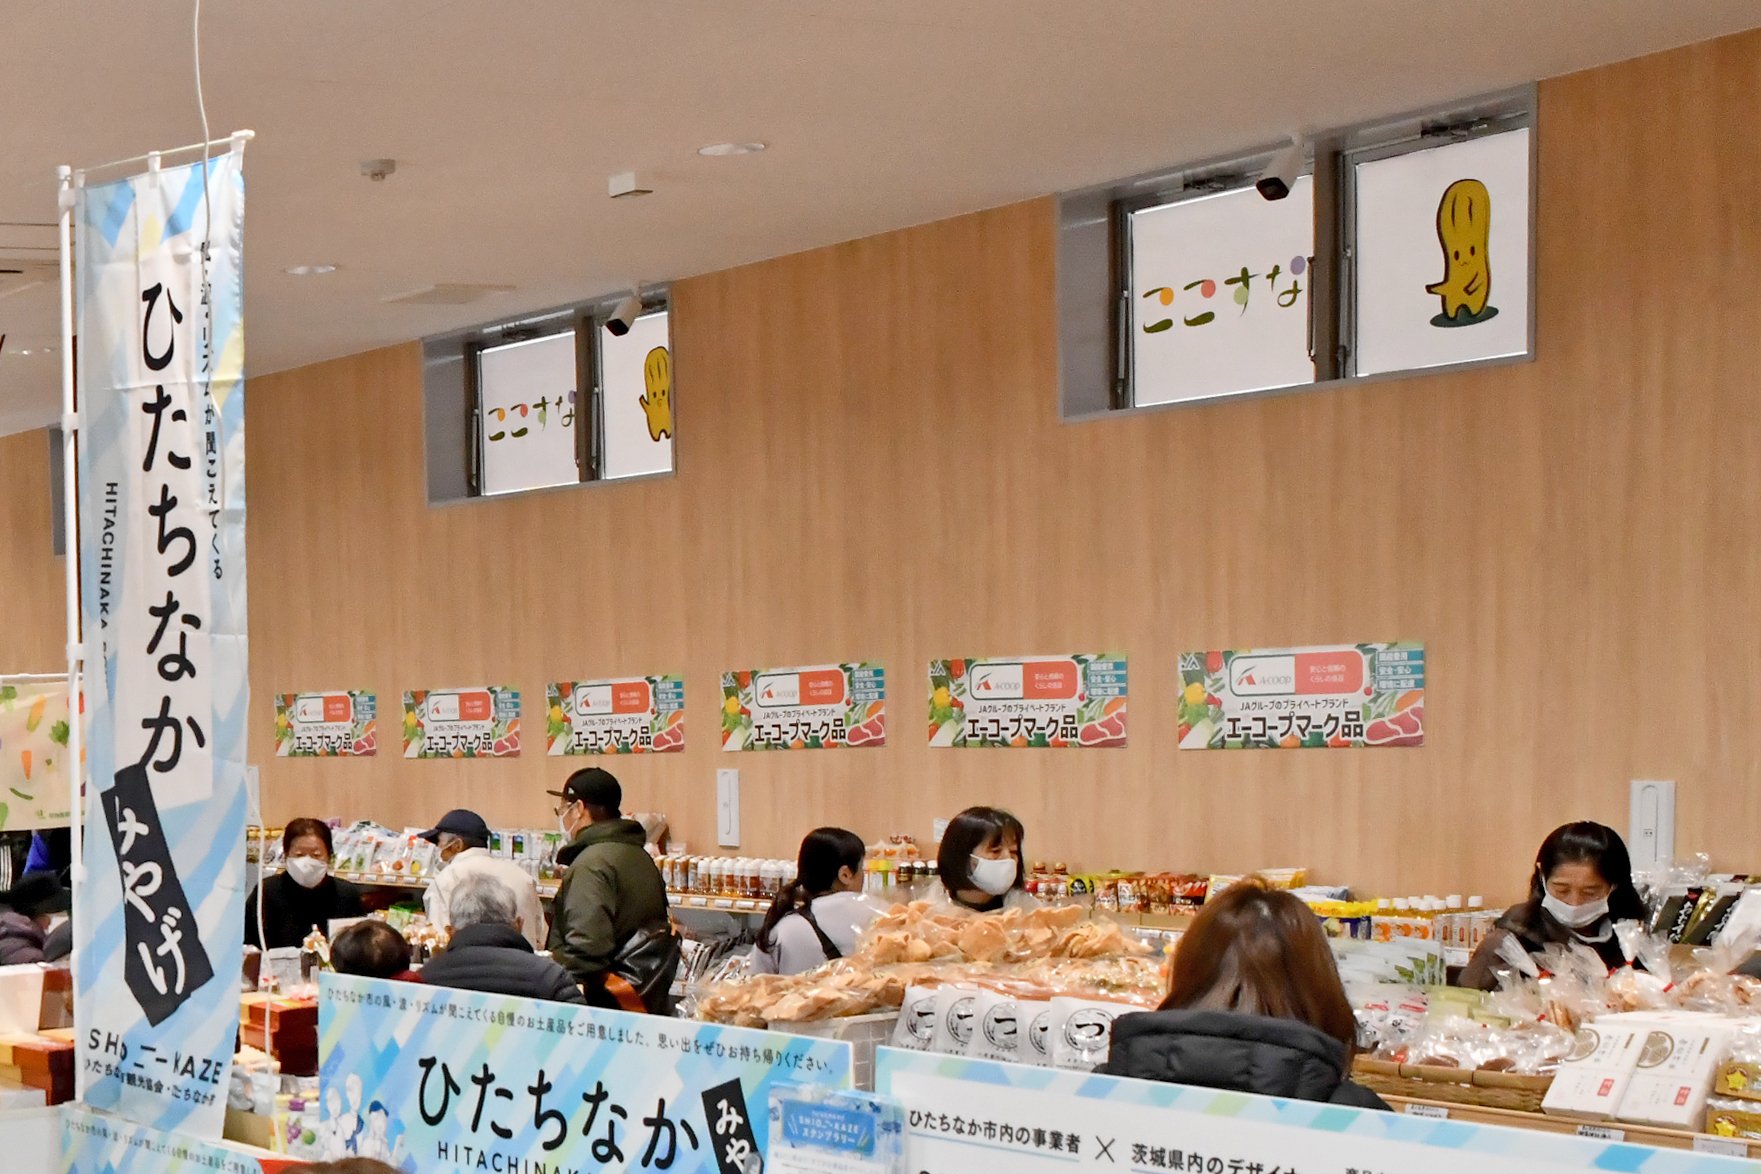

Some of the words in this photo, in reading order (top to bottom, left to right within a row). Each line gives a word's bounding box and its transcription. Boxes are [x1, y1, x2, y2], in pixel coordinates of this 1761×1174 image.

[1143, 255, 1306, 334] ここすな
[488, 390, 577, 442] ここすな
[140, 282, 206, 774] ひたちなか
[978, 702, 1067, 714] JAグループのプライベートブランド
[1240, 698, 1350, 712] JAグループのプライベートブランド
[574, 726, 653, 748] エーコープマーク品
[754, 718, 847, 743] エーコープマーク品
[967, 714, 1079, 740] エーコープマーク品
[1227, 711, 1365, 739] エーコープマーク品
[295, 731, 354, 752] エーコープマーク品
[426, 730, 493, 752] エーコープマーク品
[416, 1054, 699, 1171] ひたちなか
[715, 1098, 752, 1174] みや
[908, 1108, 1081, 1155] ひたちなか市内の事業者
